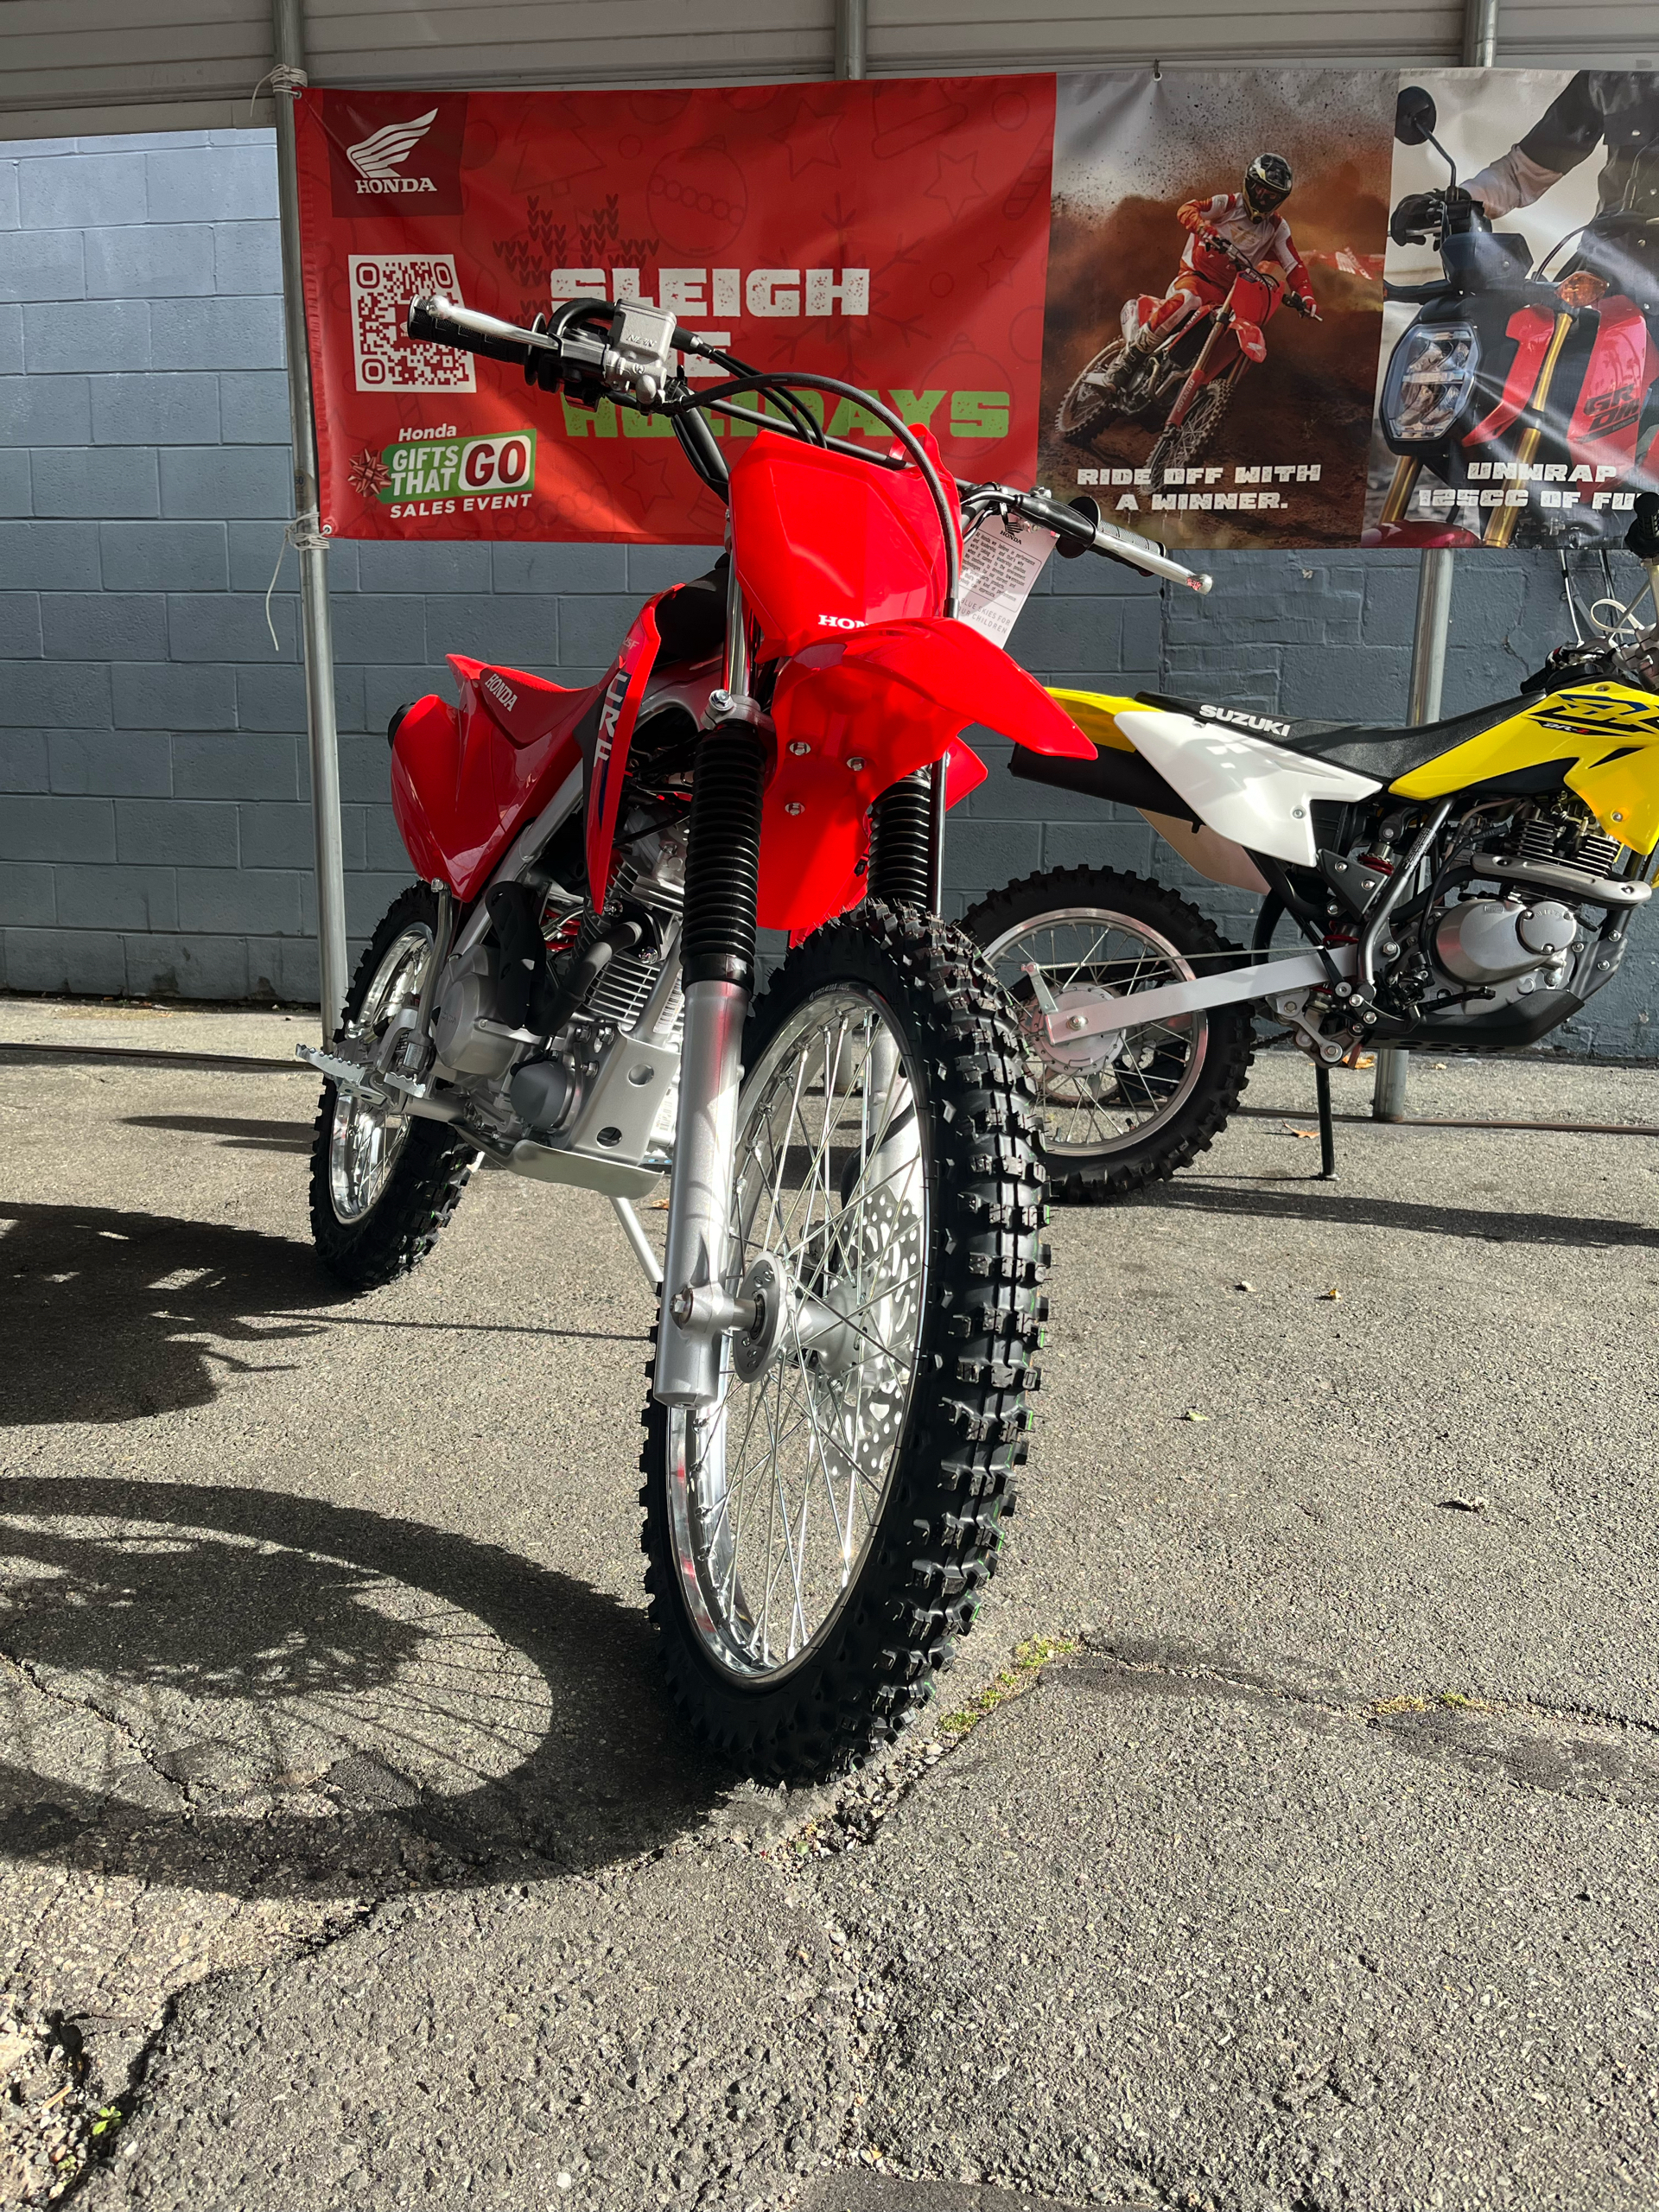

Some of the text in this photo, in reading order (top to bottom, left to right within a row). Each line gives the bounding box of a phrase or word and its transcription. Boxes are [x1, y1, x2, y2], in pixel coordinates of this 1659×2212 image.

[354, 177, 437, 194] HONDA
[550, 268, 869, 317] SLEIGH
[398, 423, 457, 442] Honda
[392, 445, 460, 471] GIFTS
[465, 440, 526, 486] GO
[391, 467, 455, 496] THAT
[1077, 464, 1321, 485] RIDE OFF WITH
[1467, 462, 1617, 482] UNWRAP
[390, 493, 532, 518] SALES EVENT
[1116, 492, 1288, 511] A WINNER.
[1420, 489, 1642, 510] 125CC OF FU
[1000, 530, 1022, 544] HONDA
[961, 598, 1011, 626] BLUE SKIES FOR
[971, 613, 1007, 634] CHILDREN
[485, 673, 518, 712] HONDA
[593, 673, 628, 767] CRF
[1199, 704, 1291, 737] SUZUKI
